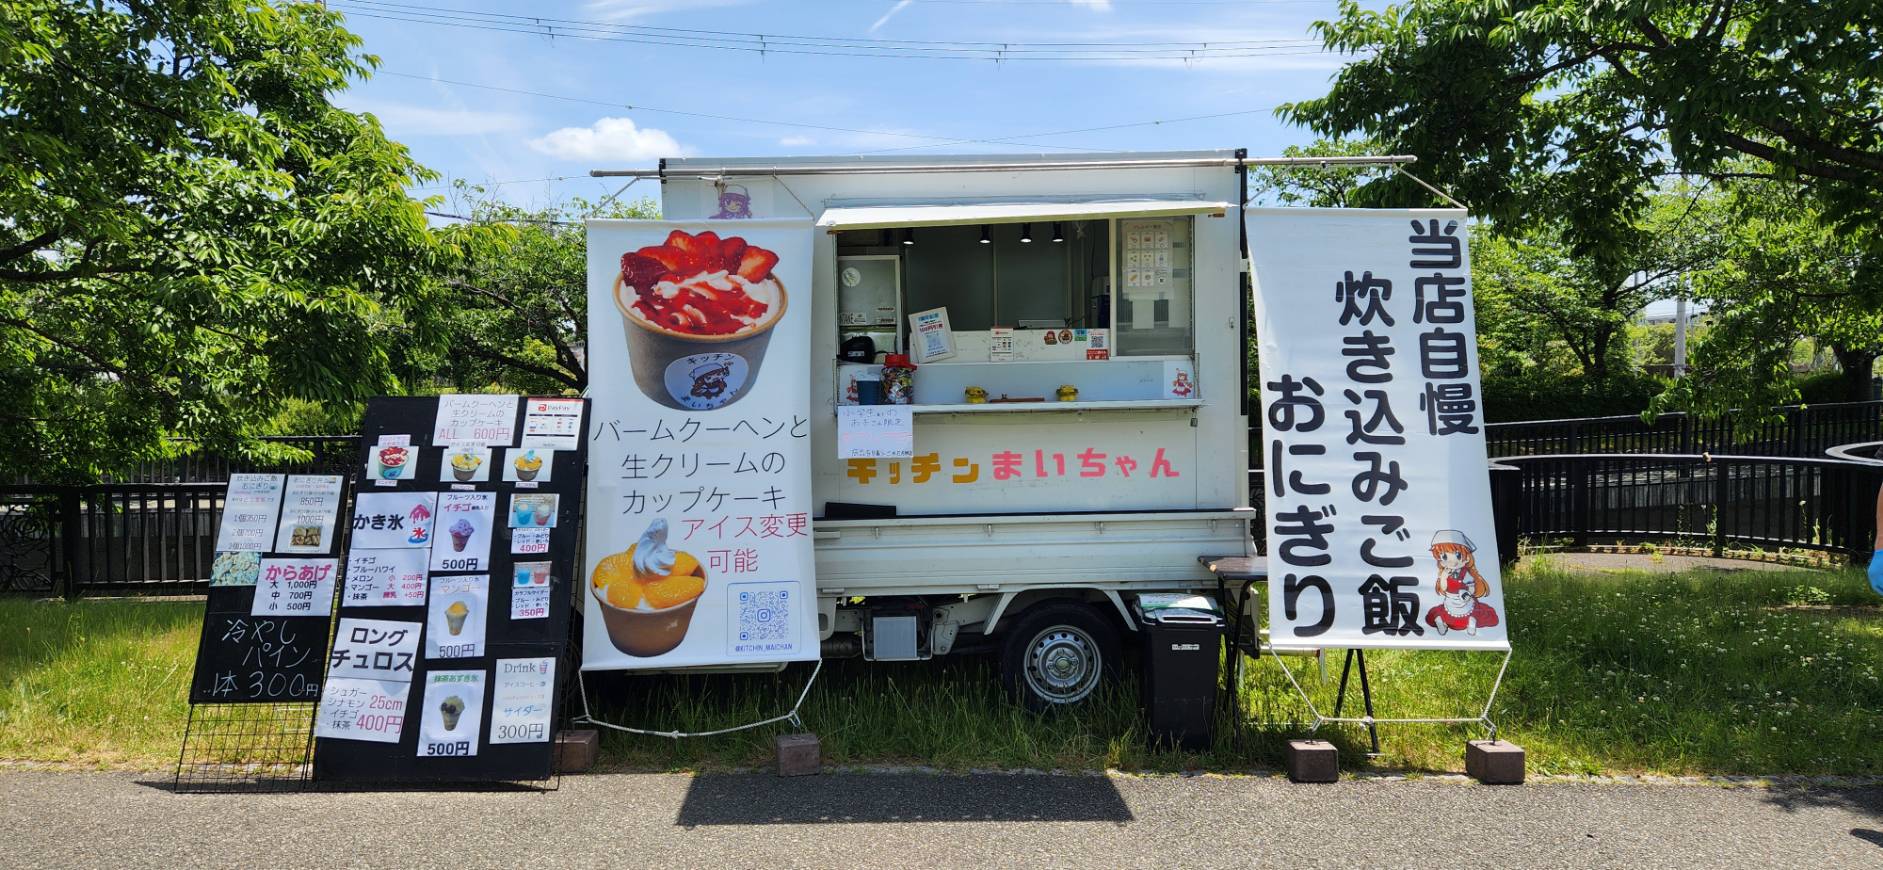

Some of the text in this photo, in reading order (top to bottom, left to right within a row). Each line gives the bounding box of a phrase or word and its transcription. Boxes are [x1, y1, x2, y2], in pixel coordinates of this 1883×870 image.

[1408, 218, 1479, 436] 当店自慢
[687, 353, 735, 364] キッチン
[444, 400, 513, 409] バームクーヘンと
[451, 409, 505, 418] 生クリームの
[450, 419, 504, 427] カップケーキ
[593, 415, 809, 443] バームクーヘンと
[438, 427, 511, 441] ALL 600円
[1335, 269, 1425, 637] 炊き込みご飯
[621, 452, 786, 479] 生クリームの
[847, 447, 1180, 485] キッチン まいちゃん
[444, 503, 471, 512] イチゴ
[622, 485, 787, 515] カップケーキ
[1266, 373, 1336, 637] おにぎり
[353, 513, 404, 530] かき氷
[681, 512, 809, 540] アイス変更
[519, 543, 546, 553] 400円
[441, 558, 479, 570] 500円
[707, 548, 759, 574] 可能
[265, 565, 332, 581] からあげ
[269, 580, 317, 590] 大 1,000円
[387, 583, 396, 591] 大
[441, 584, 480, 593] マンゴー
[271, 591, 313, 600] 中 700円
[268, 602, 311, 611] 小 500円
[519, 607, 545, 617] 350円
[221, 618, 297, 645] 冷やし
[350, 627, 408, 647] ロング
[241, 642, 311, 669] パイン
[439, 643, 476, 658] 500円
[331, 649, 414, 673] チュロス
[503, 662, 536, 674] Drink
[369, 694, 403, 711] 25cm
[503, 704, 543, 717] サイダー
[355, 714, 404, 734] 400円
[498, 723, 544, 739] 300円
[427, 741, 470, 756] 500円
